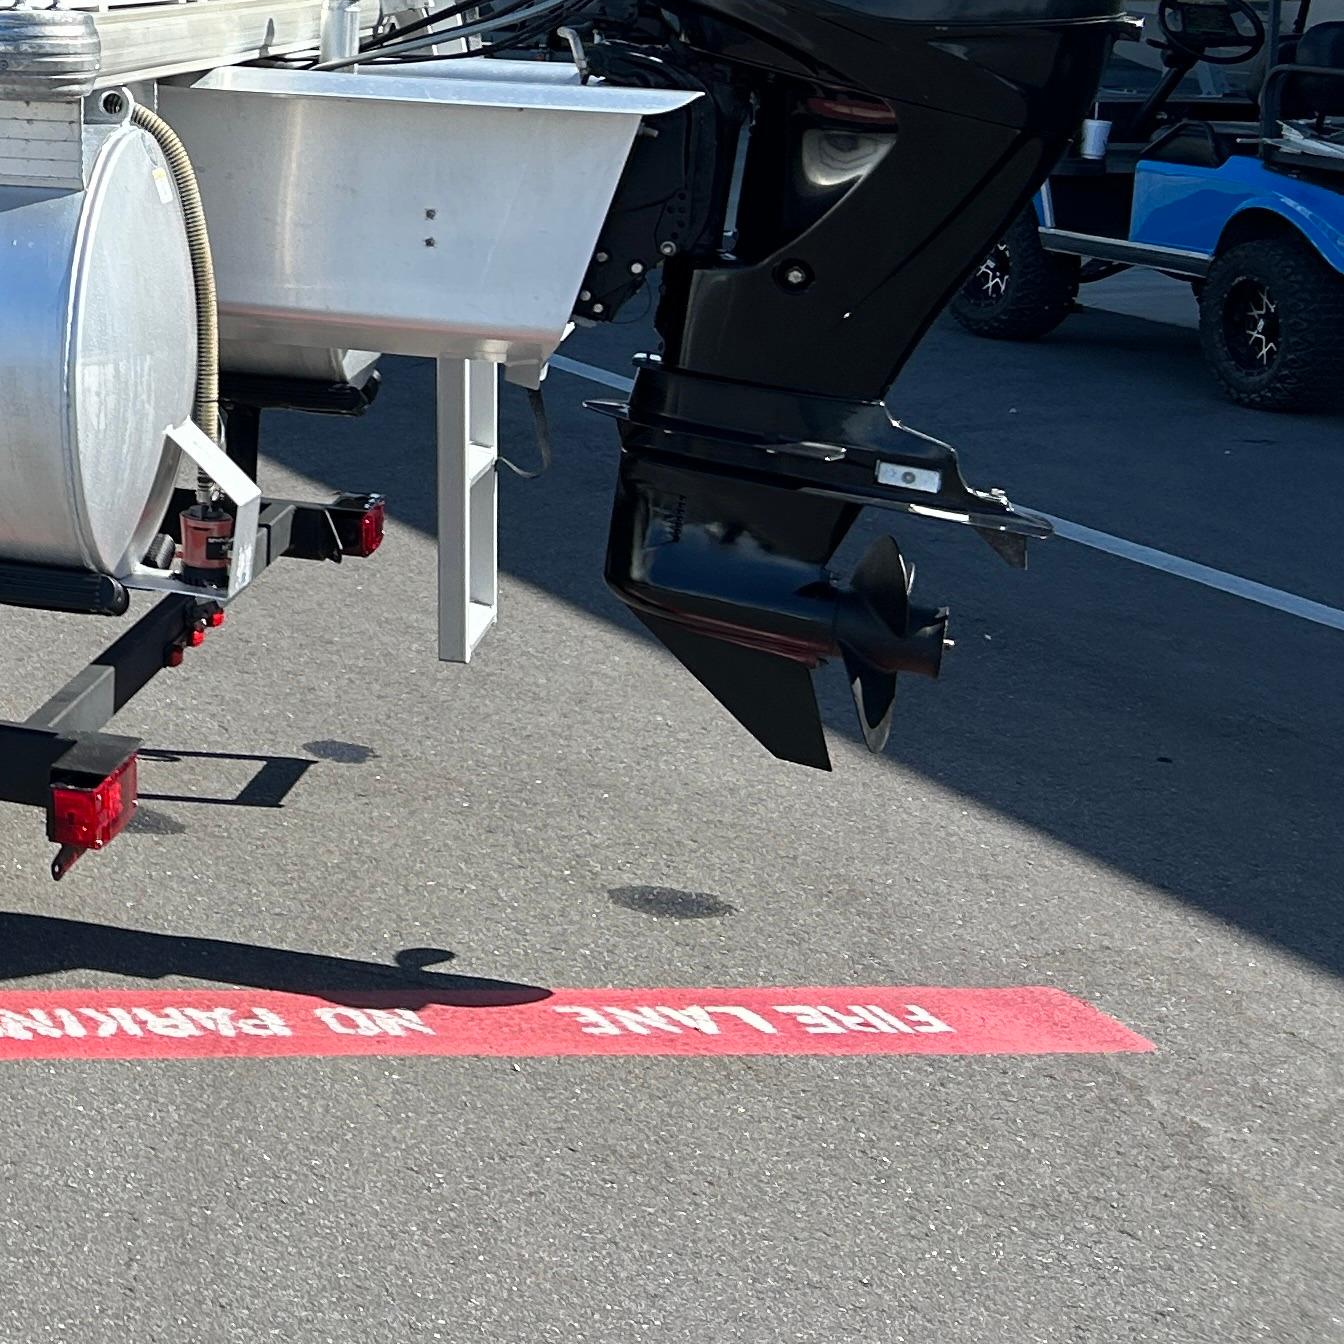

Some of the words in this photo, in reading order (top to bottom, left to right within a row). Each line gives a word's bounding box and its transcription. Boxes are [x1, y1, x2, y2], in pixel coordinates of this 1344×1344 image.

[313, 1007, 437, 1037] NO
[552, 1004, 779, 1036] LANE
[771, 1004, 958, 1035] FIRE
